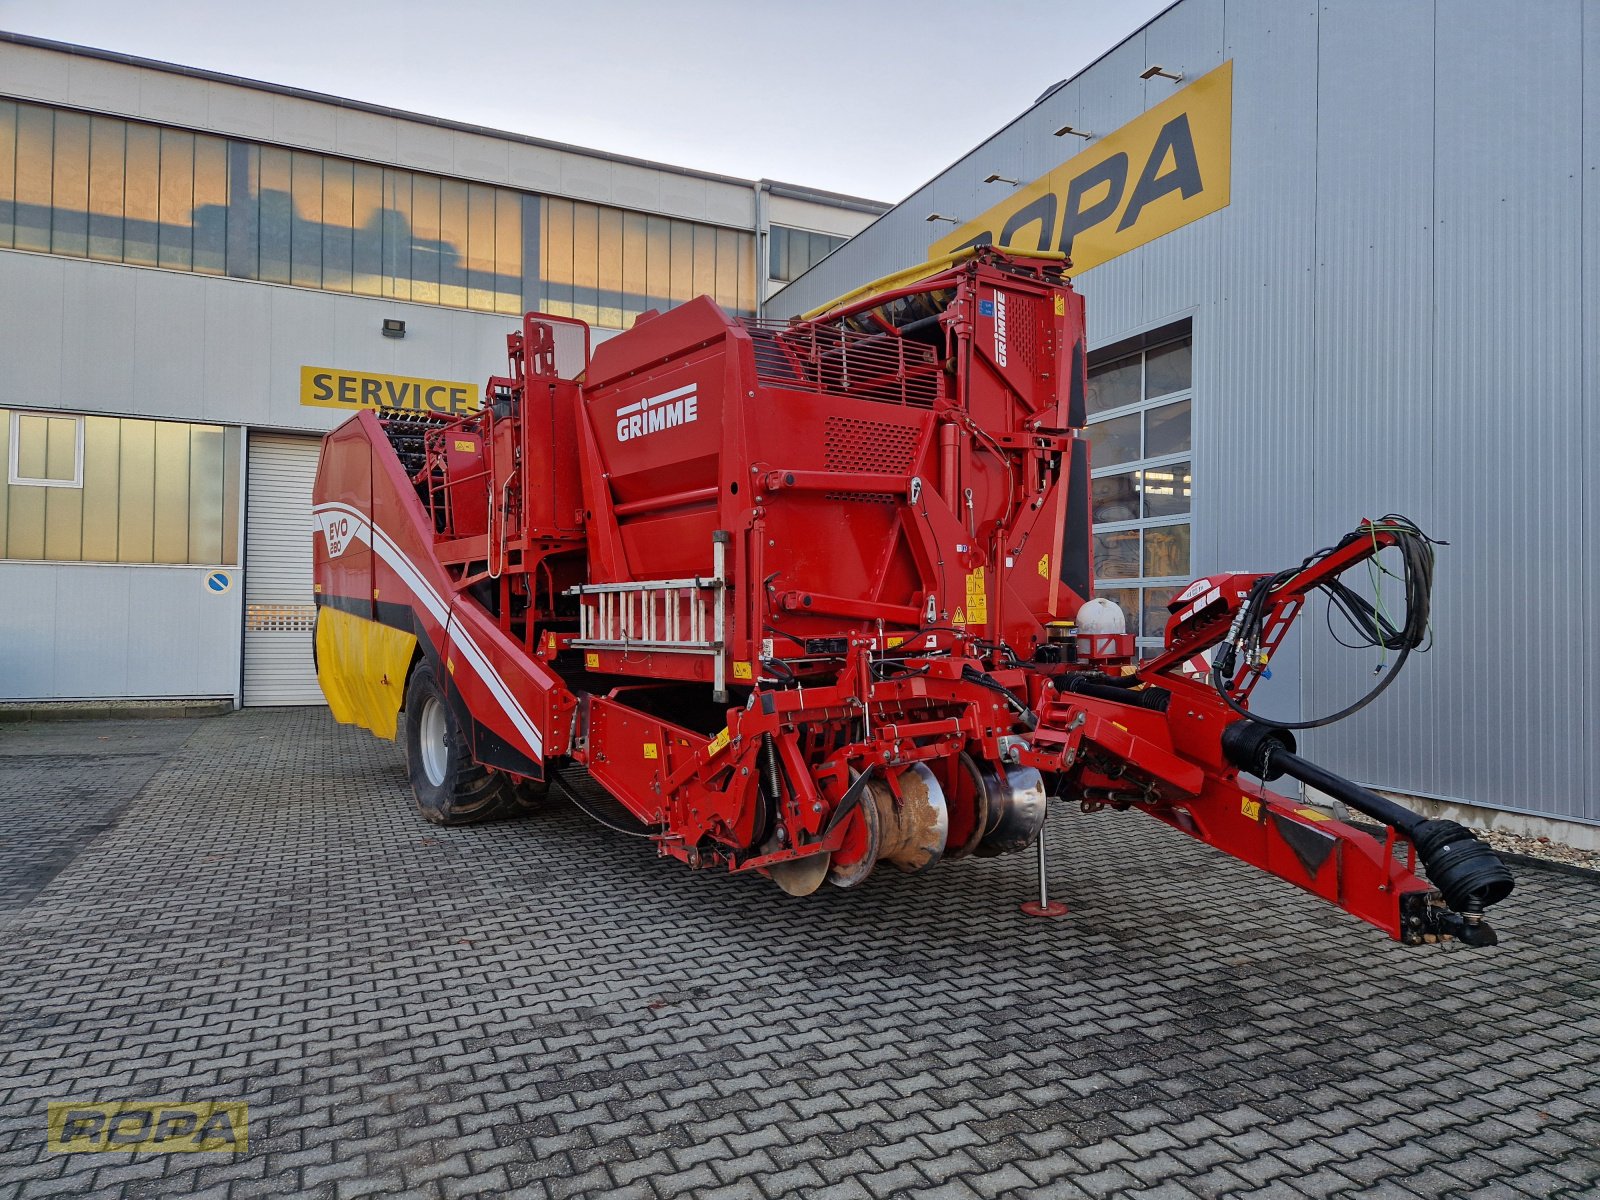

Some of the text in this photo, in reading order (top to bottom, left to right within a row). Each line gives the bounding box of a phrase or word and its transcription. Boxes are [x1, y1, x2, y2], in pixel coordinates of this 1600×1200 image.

[994, 289, 1007, 368] GRIMME
[313, 373, 467, 413] SERVICE
[616, 394, 698, 442] GRIMME
[329, 518, 348, 540] EVO
[330, 540, 342, 554] 280
